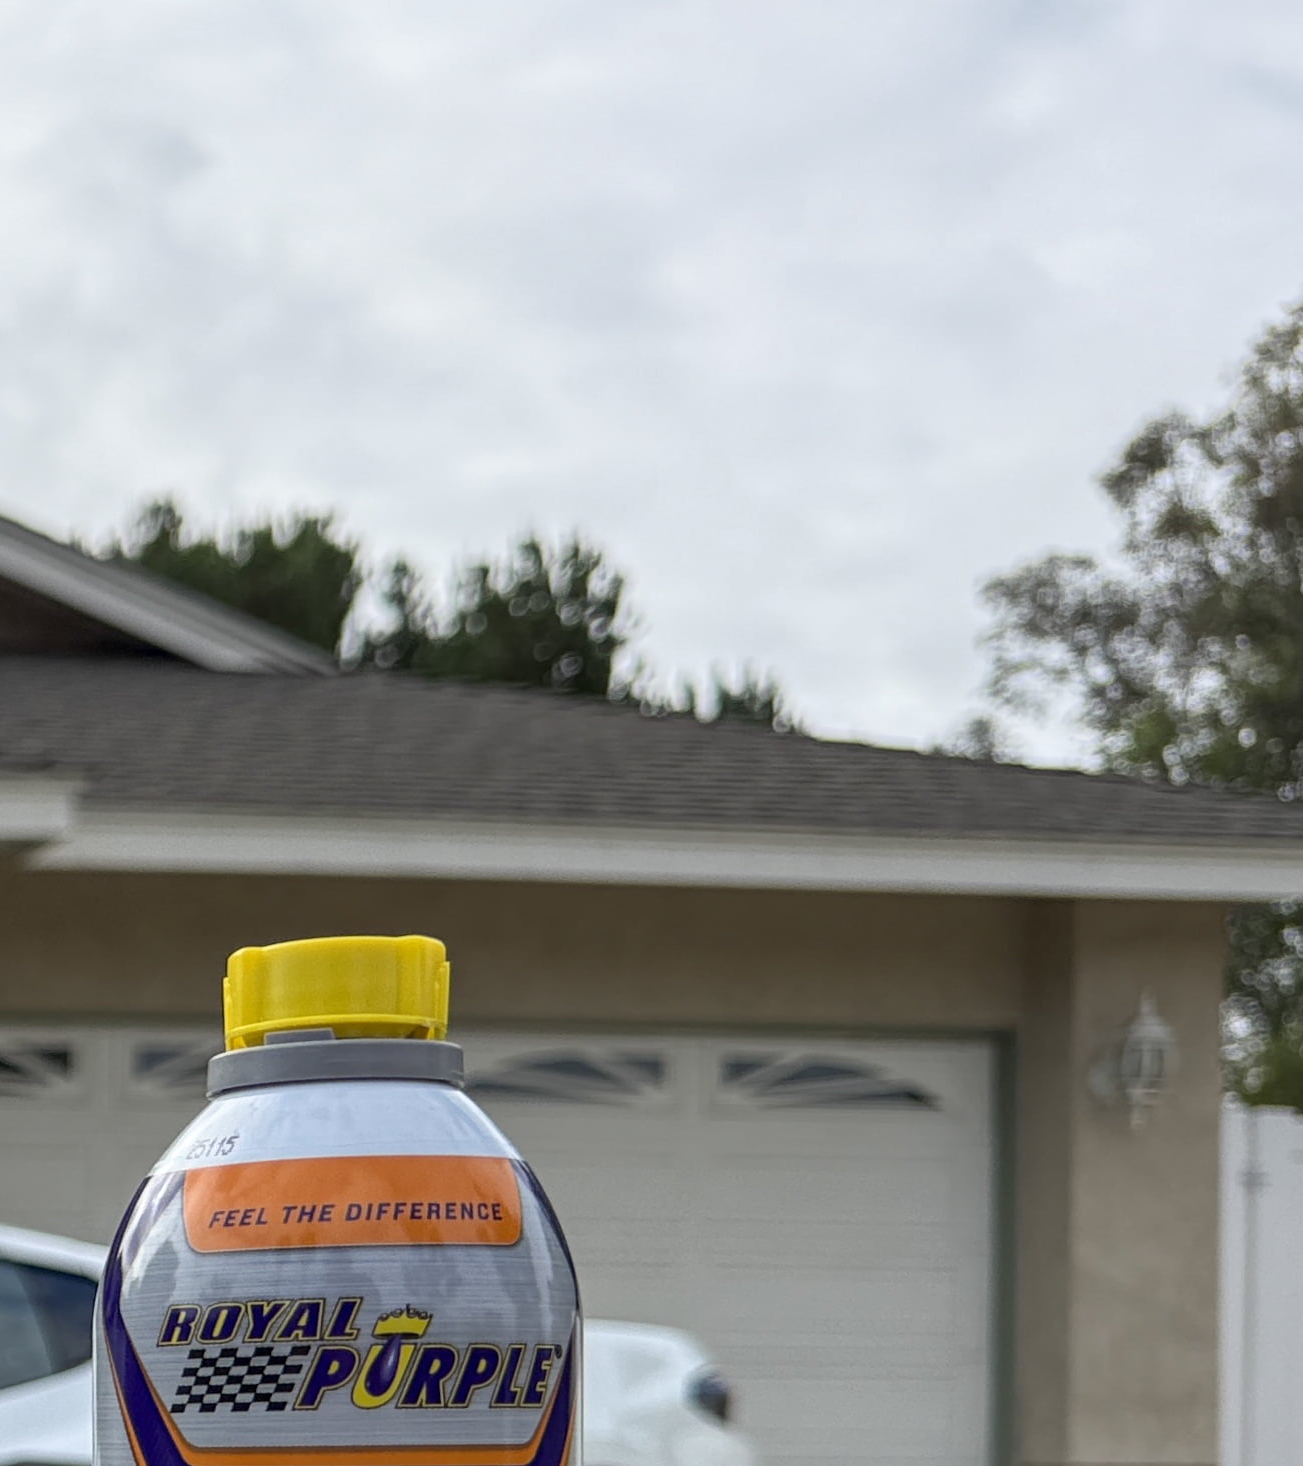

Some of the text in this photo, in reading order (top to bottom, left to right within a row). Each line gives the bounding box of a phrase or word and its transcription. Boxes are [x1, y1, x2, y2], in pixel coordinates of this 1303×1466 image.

[209, 1202, 503, 1228] FEEL THE DIFFERENCE
[157, 1297, 364, 1347] ROYAL
[293, 1342, 555, 1410] PURPLE
